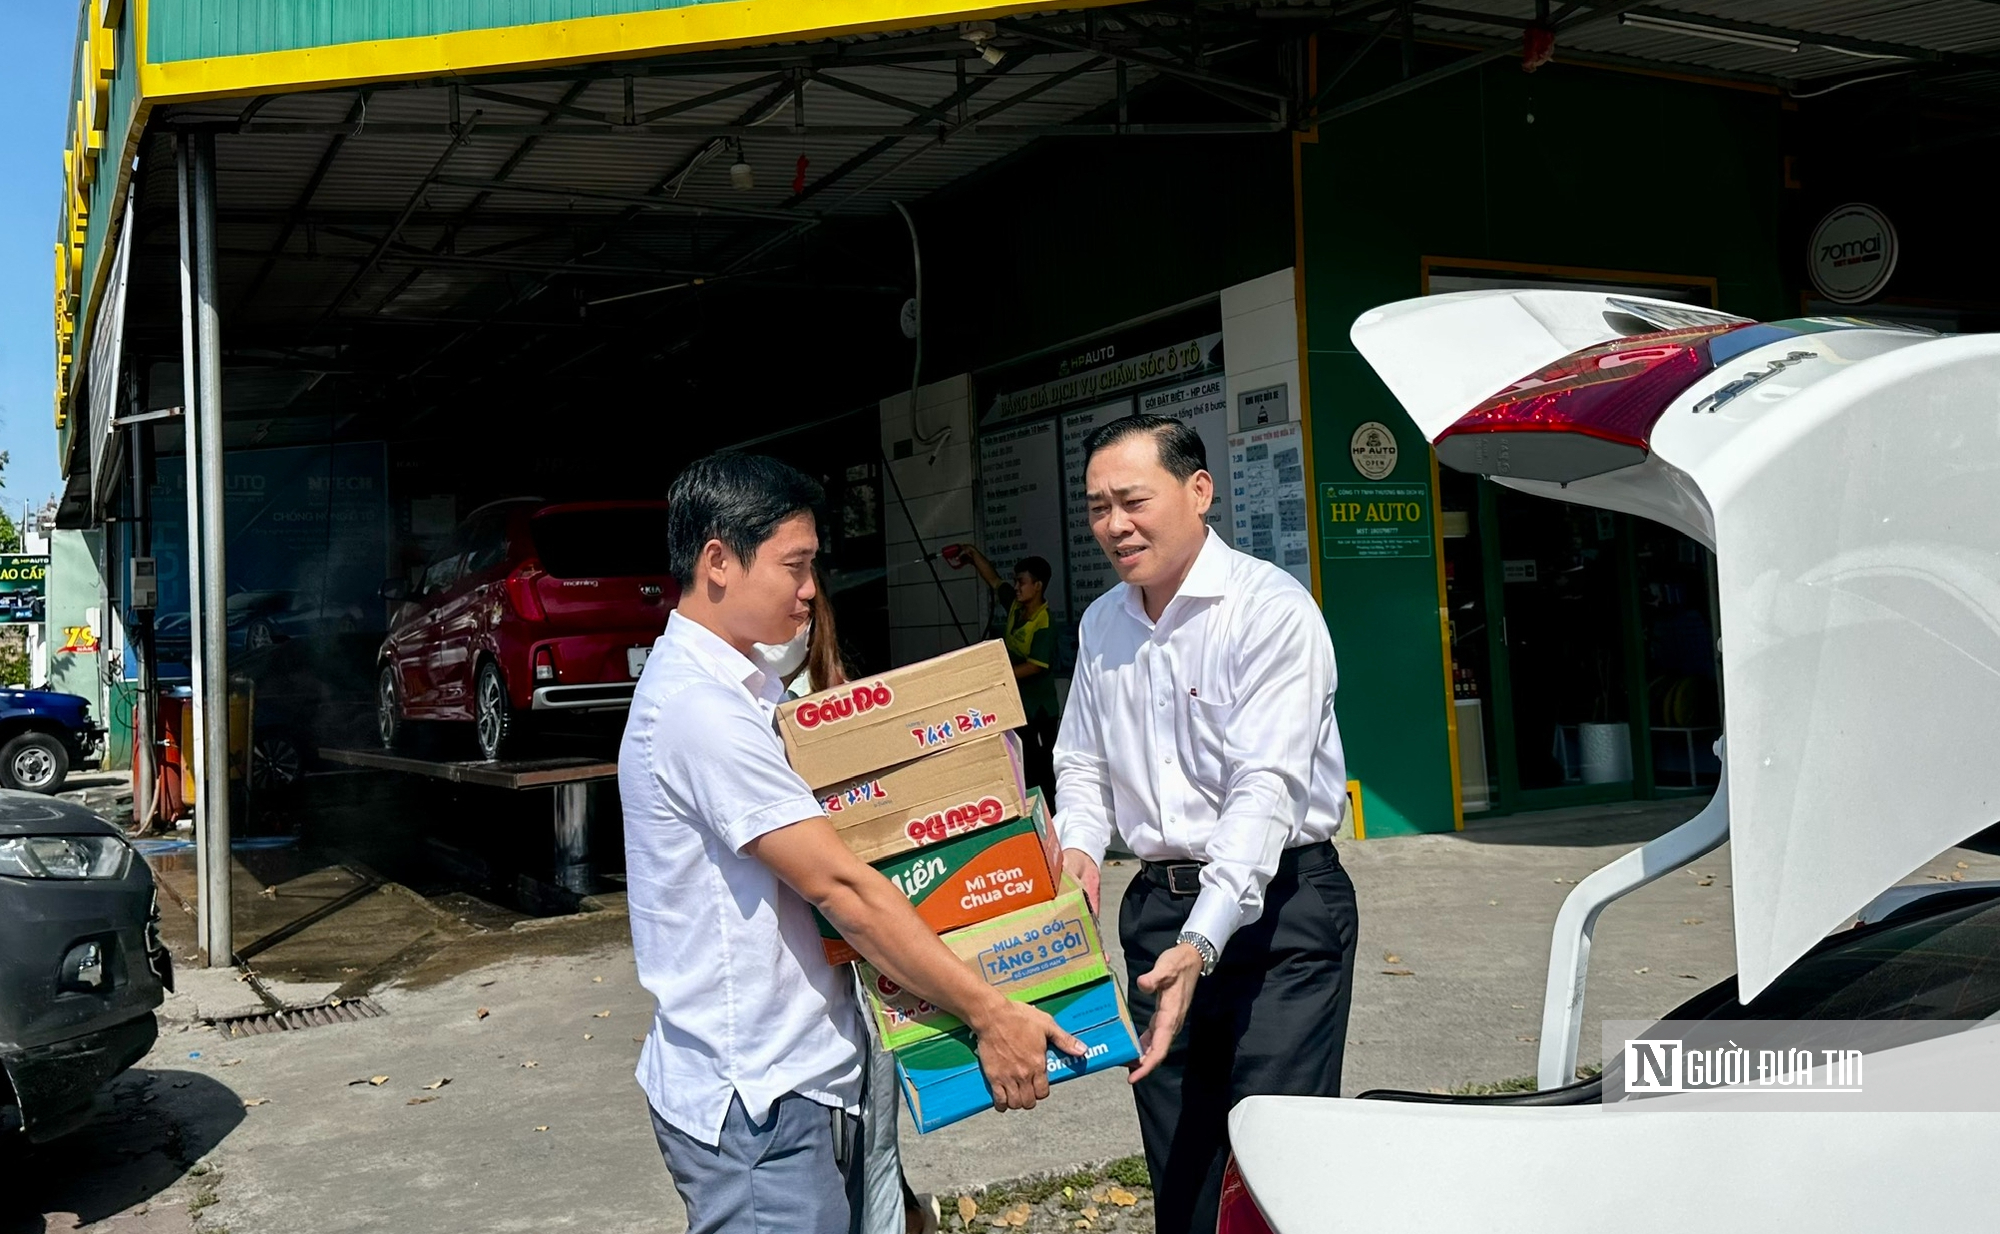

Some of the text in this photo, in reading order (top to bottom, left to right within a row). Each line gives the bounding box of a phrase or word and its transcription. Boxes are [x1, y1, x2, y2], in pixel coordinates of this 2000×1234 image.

[1821, 232, 1880, 262] 70mai
[1030, 391, 1048, 412] GIÁ
[1051, 385, 1078, 407] DỊCH
[1081, 381, 1097, 399] VỤ
[1139, 356, 1164, 379] SÓC
[1190, 387, 1200, 398] HP
[1201, 382, 1220, 395] CARE
[1331, 502, 1421, 522] HP AUTO
[645, 585, 661, 594] KIA
[911, 709, 996, 747] Thịt Bằm
[845, 780, 887, 806] Thịt
[960, 878, 1034, 910] Chua Cay
[964, 866, 1023, 893] Mì Tôm
[993, 919, 1065, 953] MUA 30 GÓI
[987, 932, 1082, 976] TẶNG 3 GÓI
